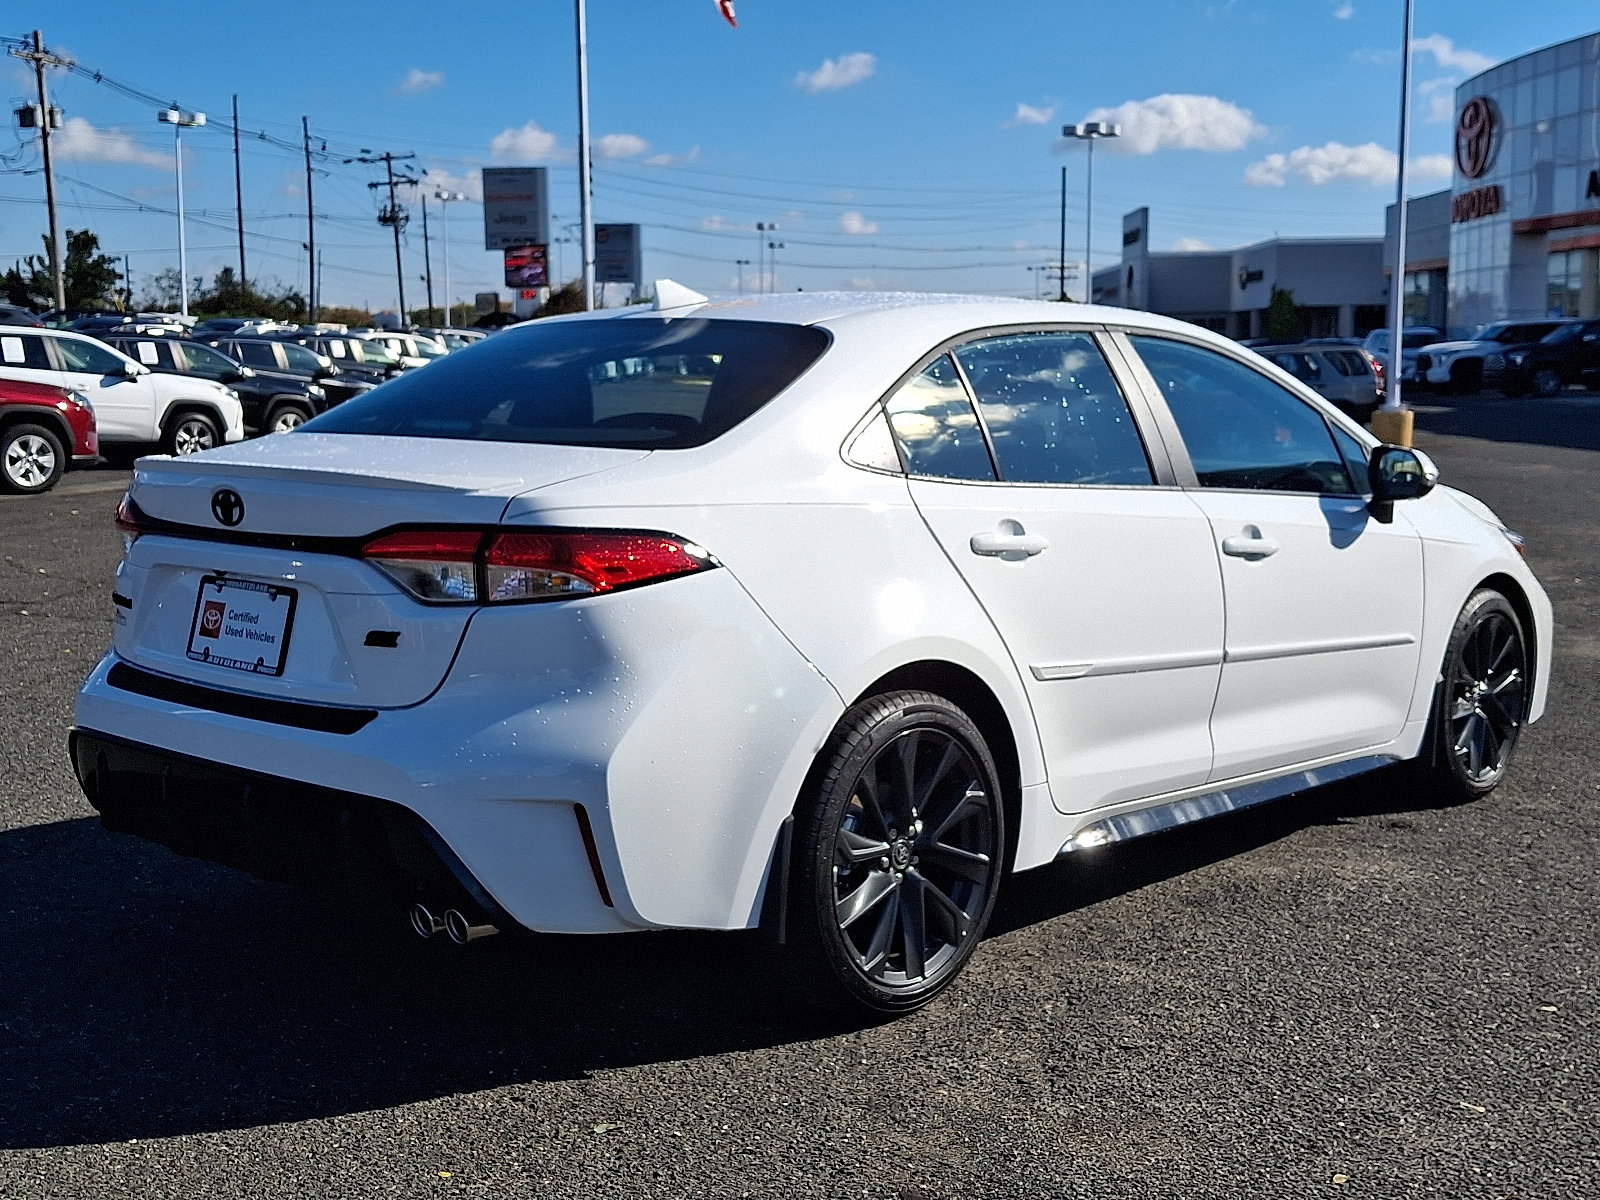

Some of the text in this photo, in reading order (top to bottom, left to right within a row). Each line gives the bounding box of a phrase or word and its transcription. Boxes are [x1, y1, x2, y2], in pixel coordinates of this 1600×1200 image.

[228, 609, 259, 624] Certified
[225, 625, 276, 644] Used Vehicles
[208, 655, 254, 671] AUTOLAND
